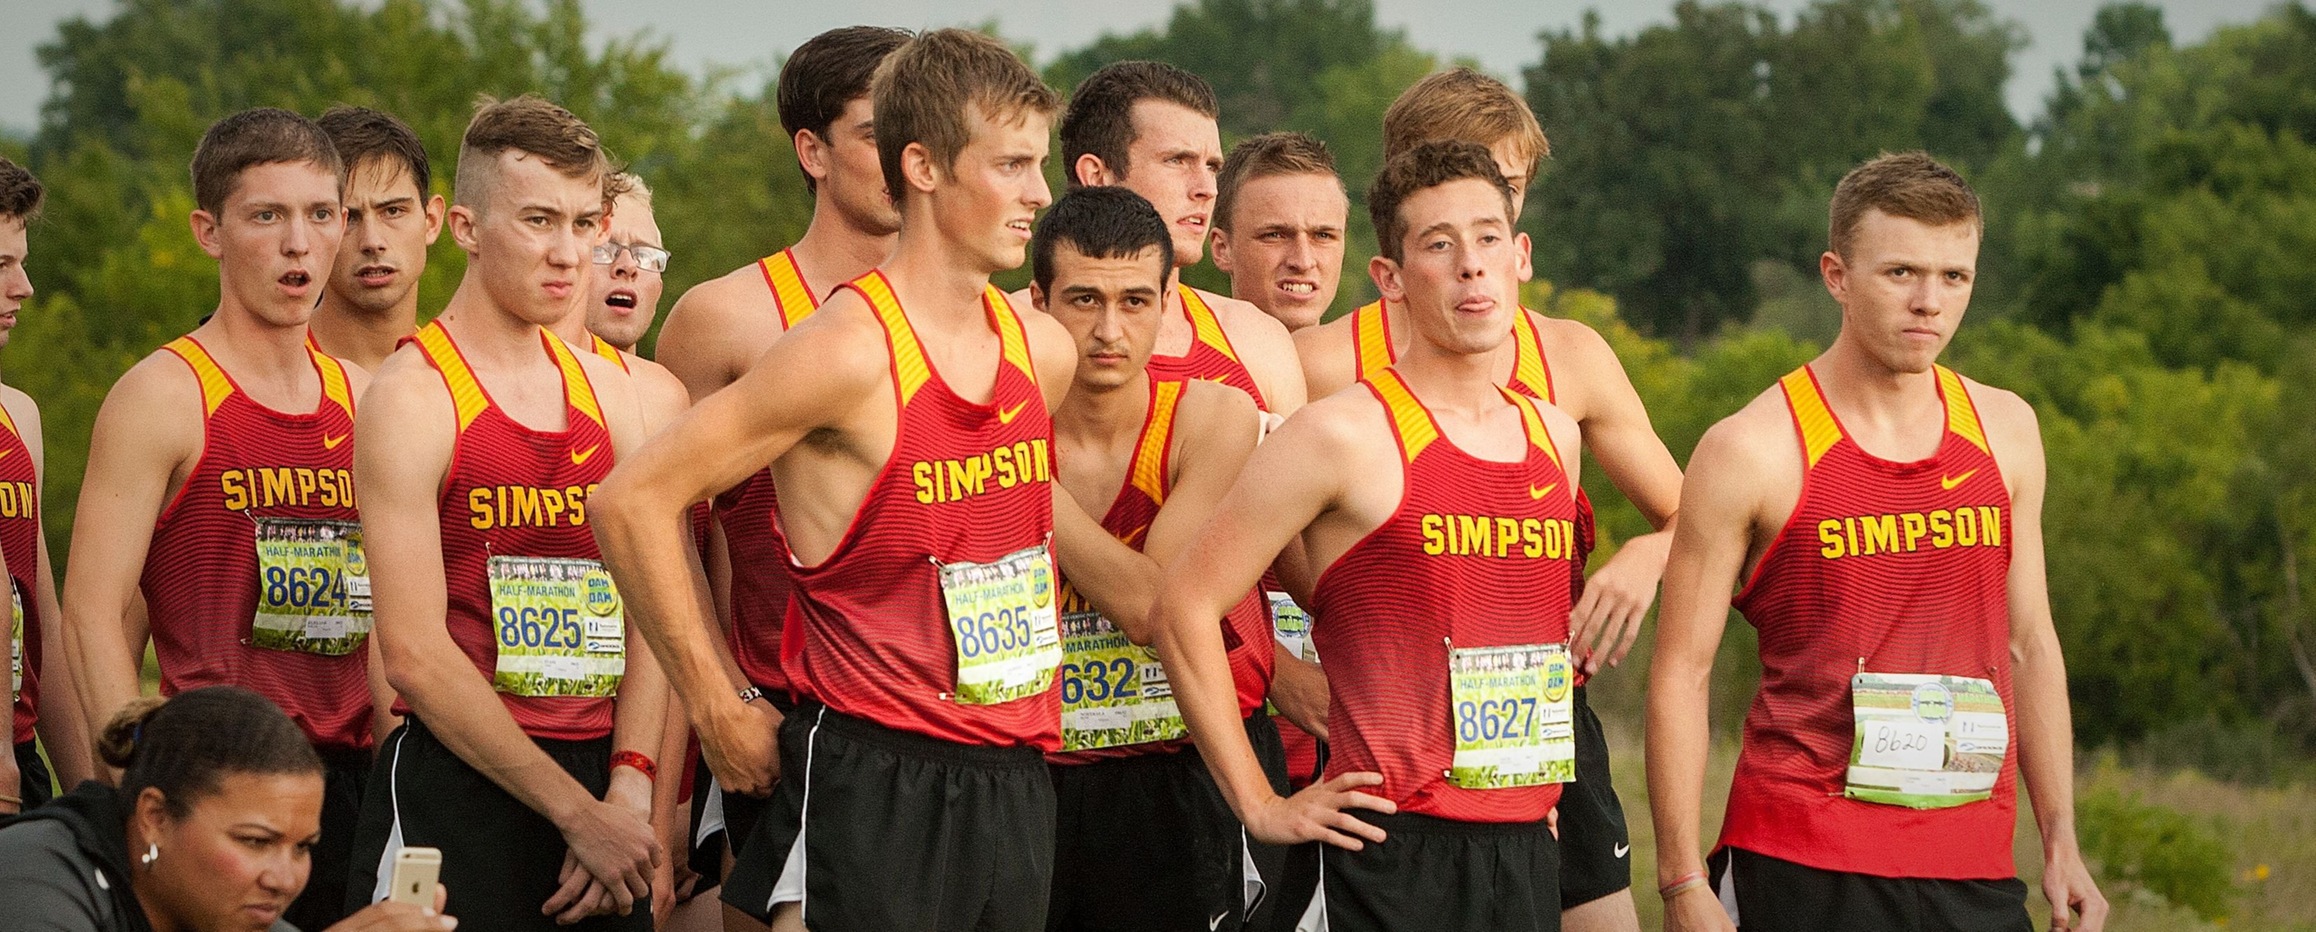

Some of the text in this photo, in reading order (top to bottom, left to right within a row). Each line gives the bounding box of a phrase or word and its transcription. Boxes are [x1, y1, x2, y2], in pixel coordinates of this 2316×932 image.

[220, 467, 359, 512] SIMPSO
[911, 438, 1051, 505] SIMPSON
[0, 481, 33, 520] ON
[1817, 505, 2001, 560] SIMPSON
[266, 566, 347, 608] 8624
[500, 585, 576, 597] HALF-MARATHON
[955, 583, 1025, 605] HALF-MARATHON
[499, 606, 582, 649] 8625
[957, 605, 1030, 658] 8635
[1460, 675, 1537, 690] HALF-MARATHON
[1458, 697, 1537, 742] 8627
[1875, 725, 1928, 754] 8620
